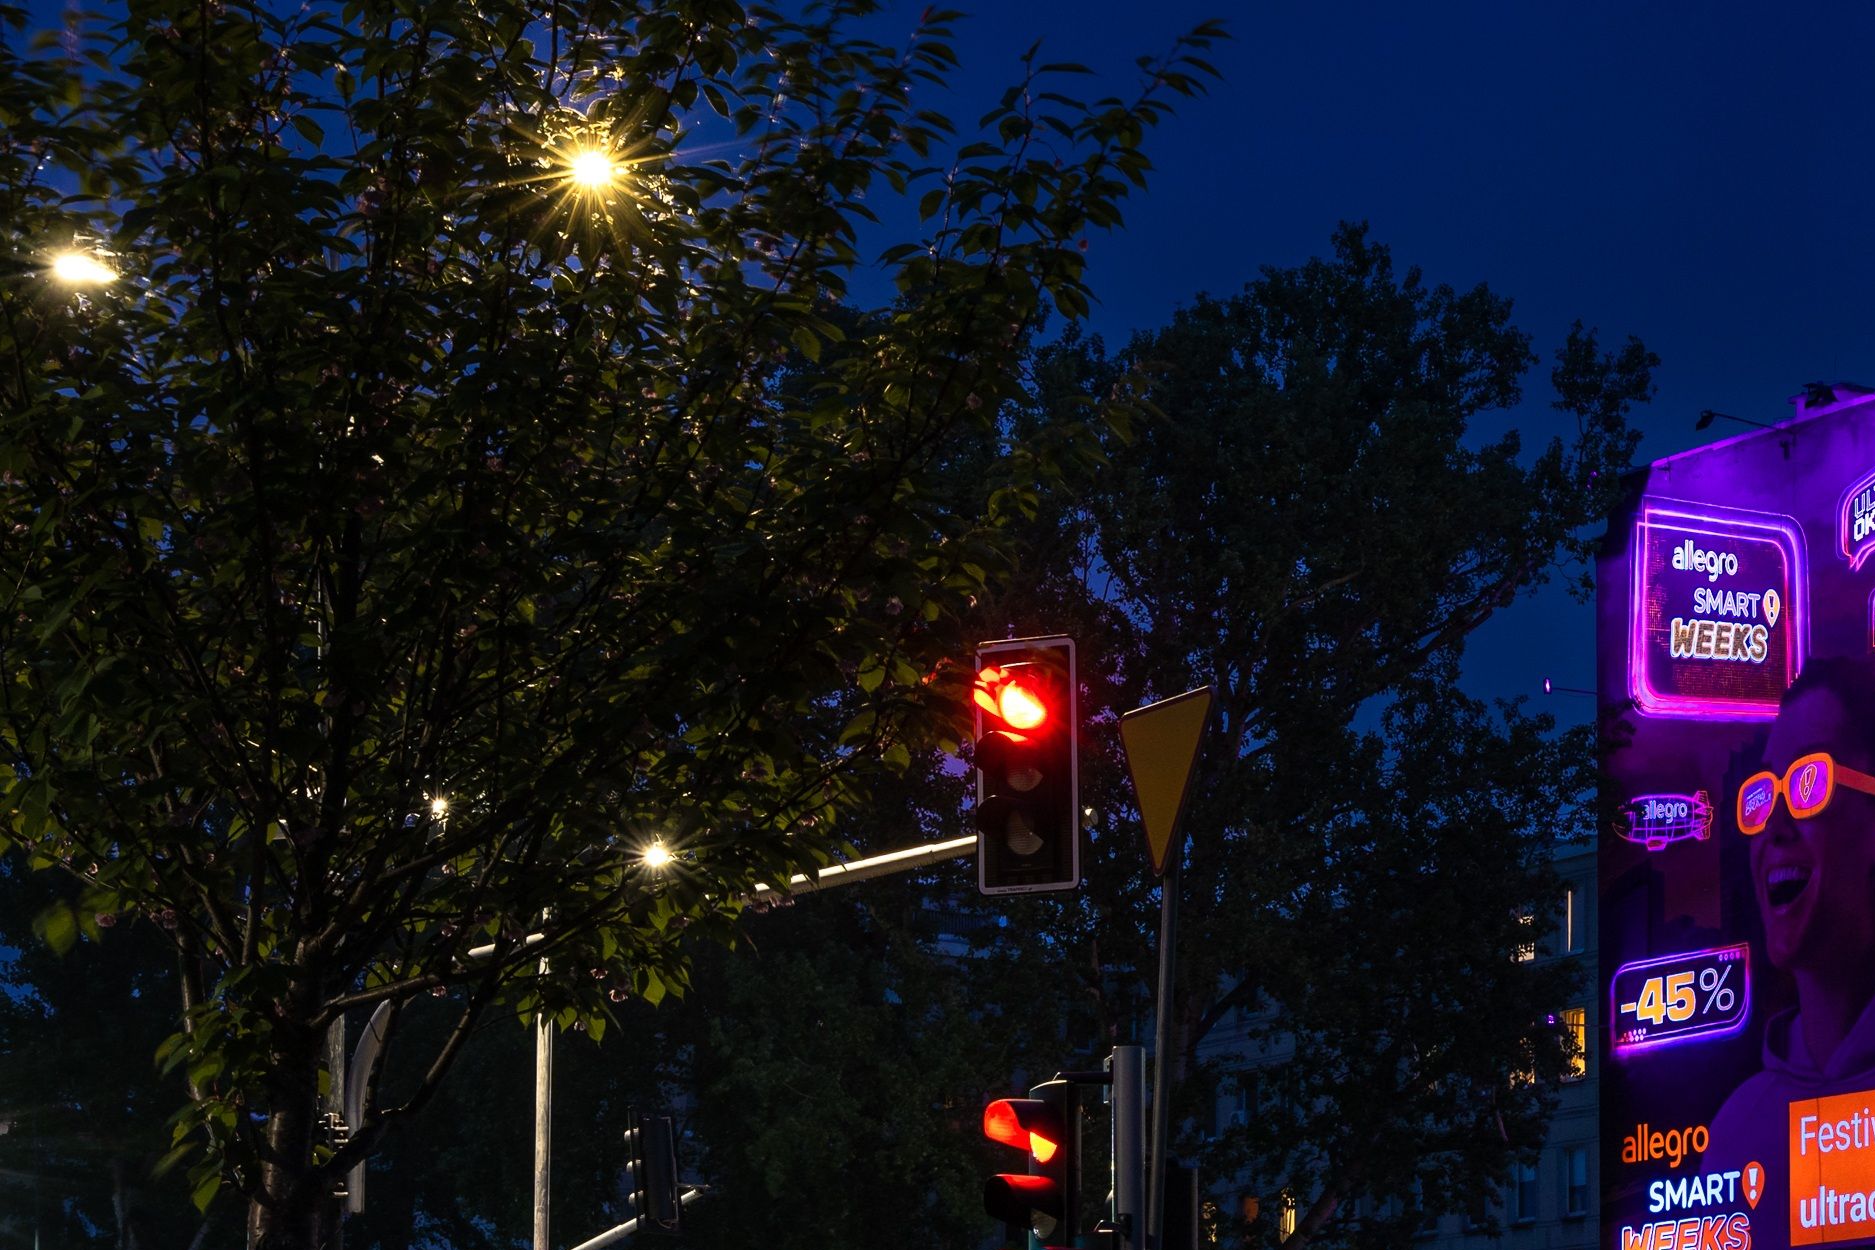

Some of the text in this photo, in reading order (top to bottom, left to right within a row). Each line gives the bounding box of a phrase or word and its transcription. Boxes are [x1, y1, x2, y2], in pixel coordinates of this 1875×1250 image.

[1672, 539, 1738, 582] allegro
[1670, 617, 1769, 663] WEEKS
[1620, 964, 1735, 1026] -45%
[1622, 1123, 1709, 1168] allegro
